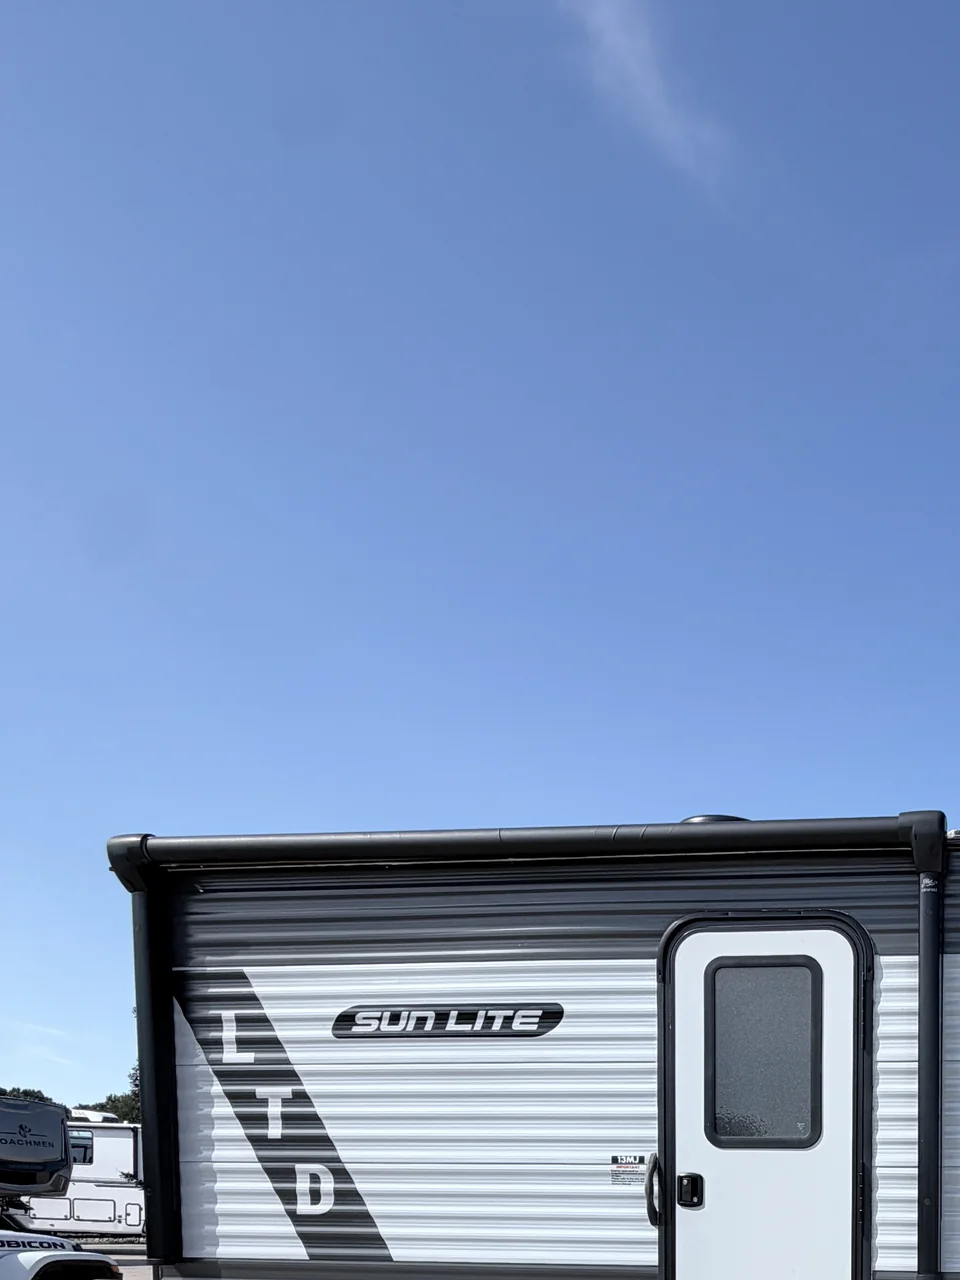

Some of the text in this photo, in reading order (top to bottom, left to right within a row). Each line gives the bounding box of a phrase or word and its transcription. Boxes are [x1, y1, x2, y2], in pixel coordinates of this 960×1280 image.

[351, 1010, 543, 1032] SUN LITE
[0, 1138, 55, 1148] OACHMEN
[617, 1155, 640, 1164] 13MJ
[0, 1240, 66, 1250] BICON
